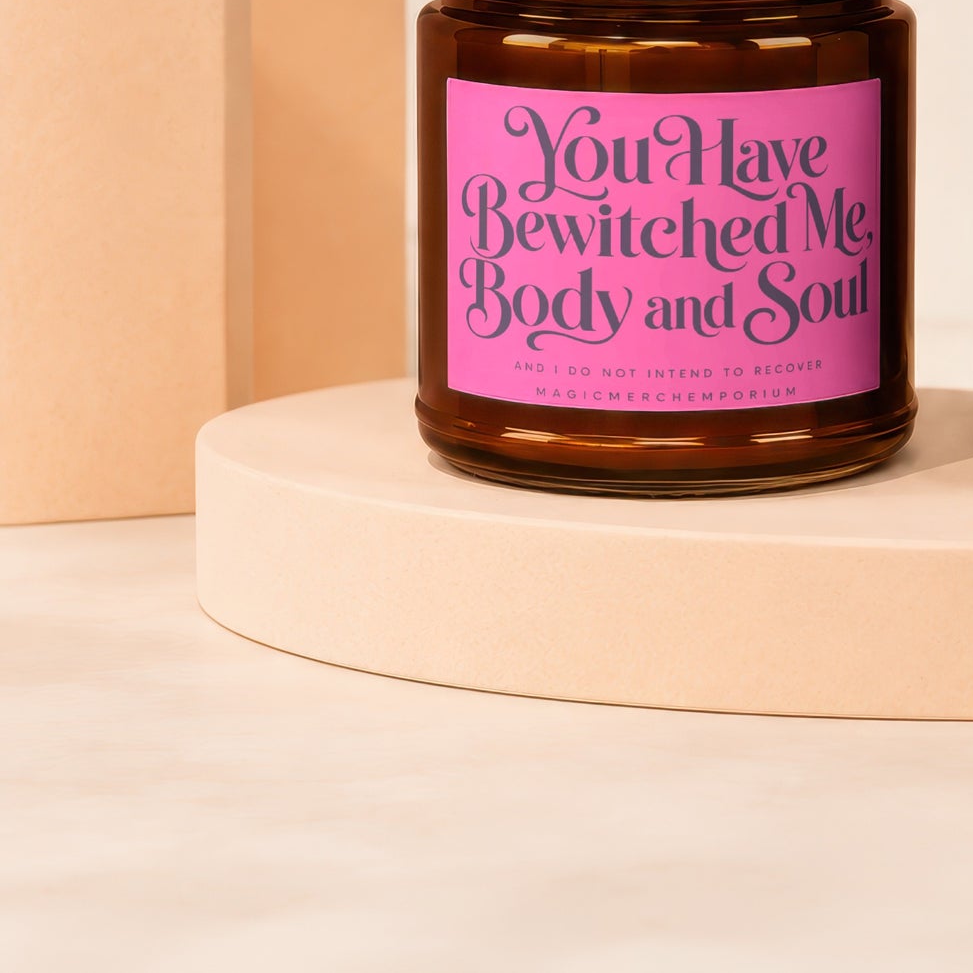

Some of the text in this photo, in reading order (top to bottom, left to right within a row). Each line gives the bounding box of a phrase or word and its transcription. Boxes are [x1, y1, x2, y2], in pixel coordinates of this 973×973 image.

[504, 105, 830, 203] You Have
[461, 173, 875, 273] Bewitched Me,
[459, 256, 870, 352] Body and Soul
[514, 359, 824, 379] AND I DO NOT INTEND TO RECOVER
[535, 386, 798, 403] MAGICMERCHEMPORIUM
